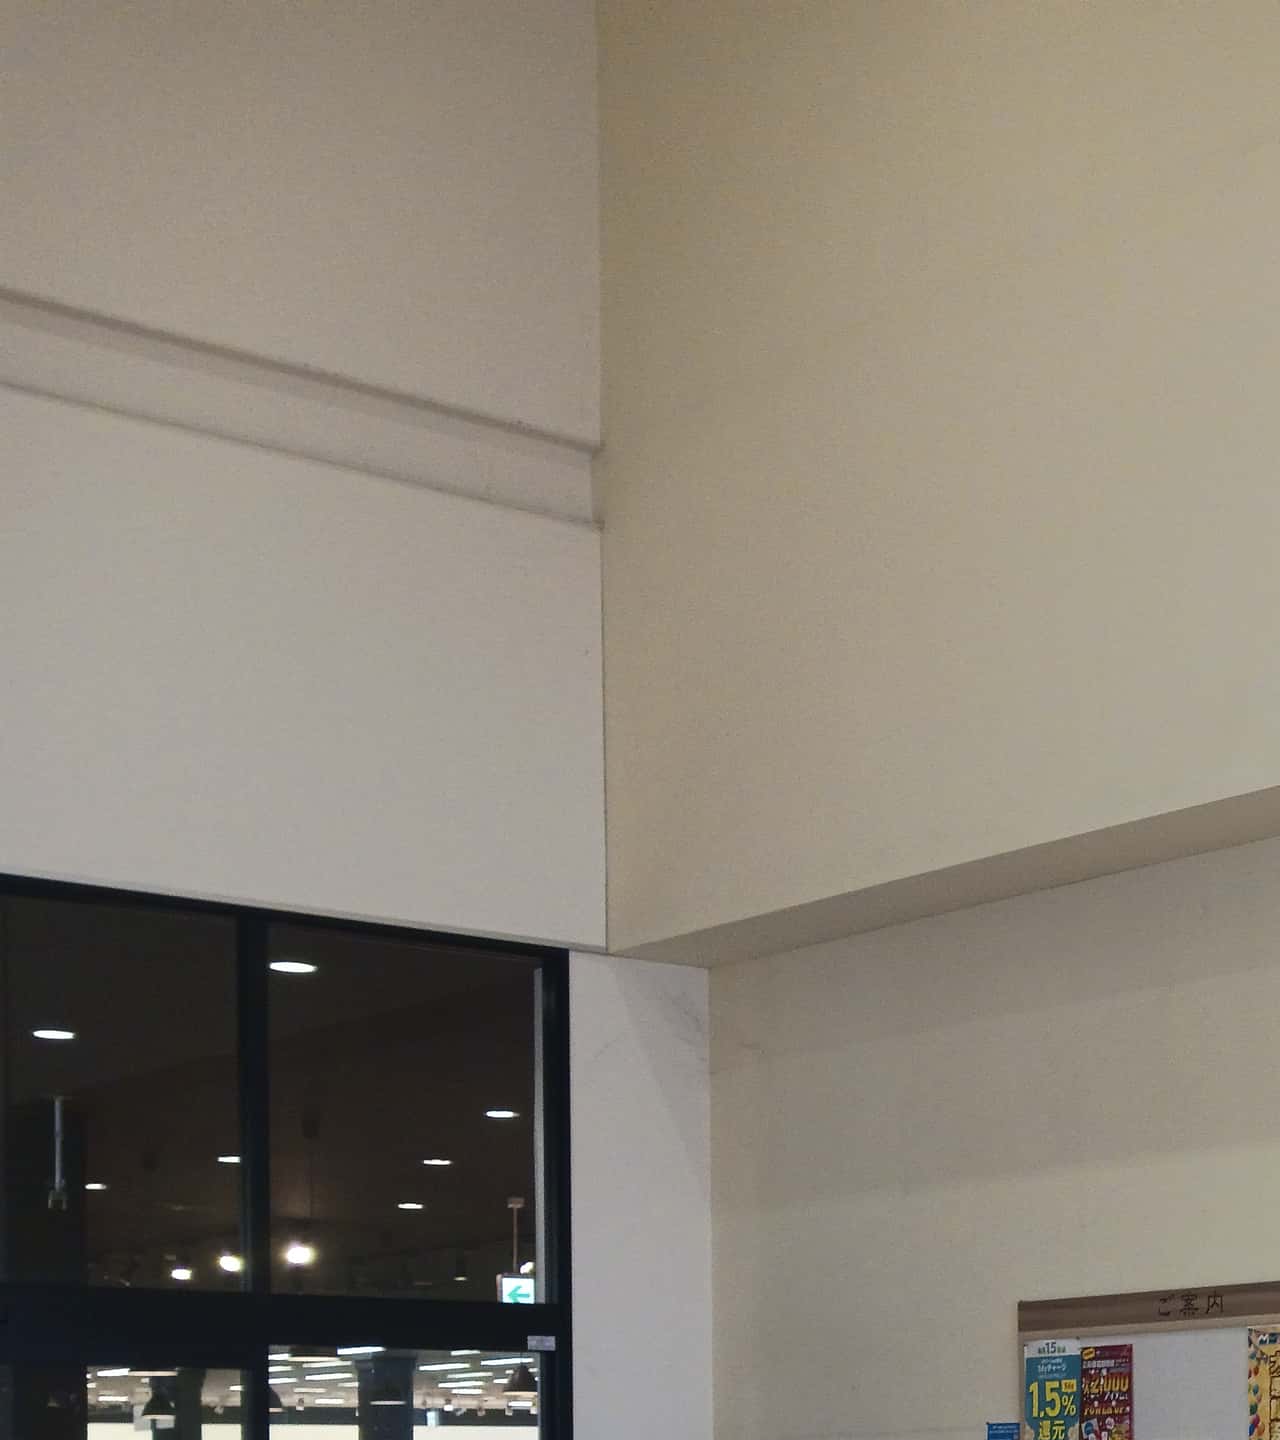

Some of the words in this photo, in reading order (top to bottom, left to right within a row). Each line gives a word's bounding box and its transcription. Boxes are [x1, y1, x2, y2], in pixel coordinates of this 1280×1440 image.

[1157, 1292, 1224, 1317] ご案内
[1029, 1380, 1077, 1418] 1.5%
[1038, 1420, 1066, 1440] 還元
